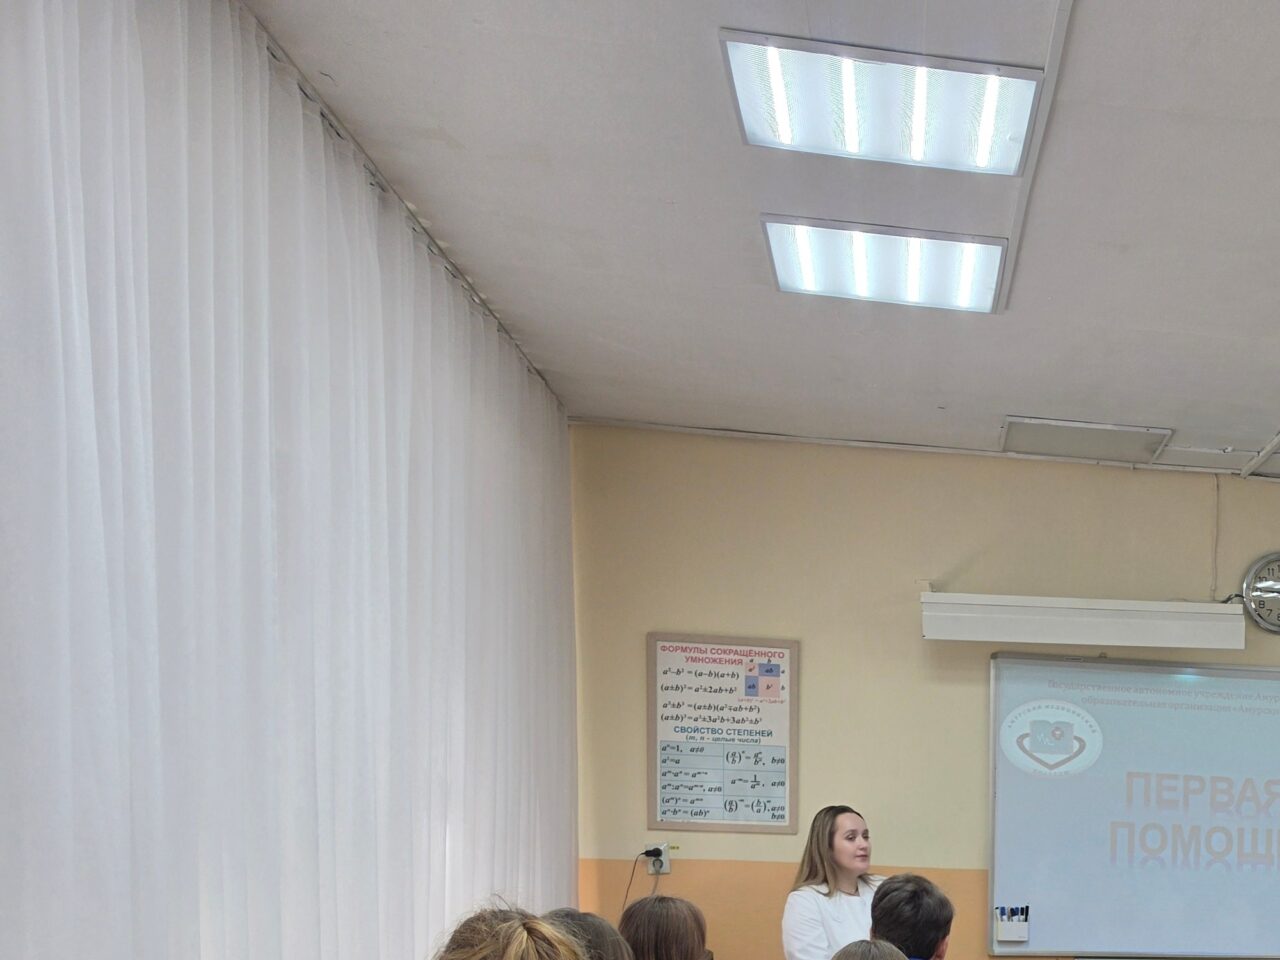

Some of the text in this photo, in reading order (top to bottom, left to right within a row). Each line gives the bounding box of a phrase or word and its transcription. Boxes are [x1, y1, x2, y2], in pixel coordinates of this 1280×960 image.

[1267, 567, 1275, 577] 11
[1258, 600, 1266, 609] 8
[1265, 608, 1273, 617] 7
[660, 645, 708, 654] ФОРМУЛЫ
[684, 656, 743, 666] УМНОЖЕНИЯ
[673, 725, 773, 738] СВОЙСТВО СТЕПЕНЕЙ
